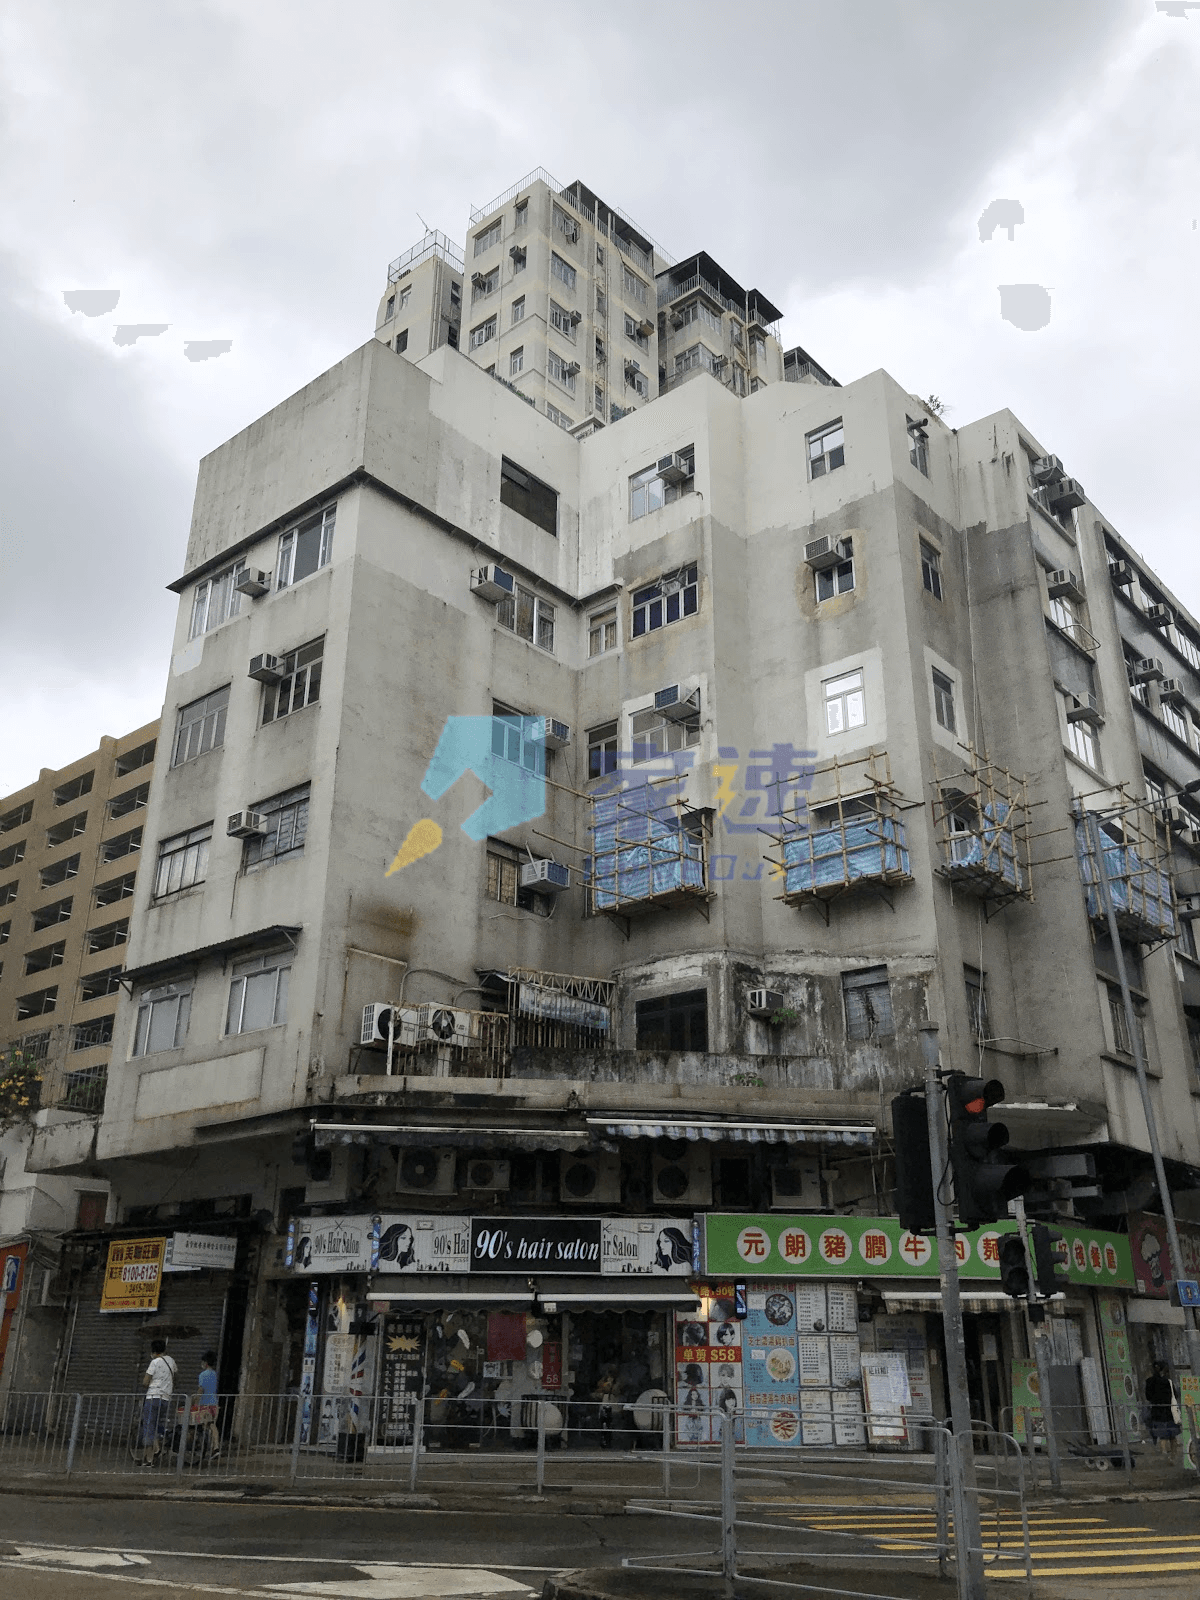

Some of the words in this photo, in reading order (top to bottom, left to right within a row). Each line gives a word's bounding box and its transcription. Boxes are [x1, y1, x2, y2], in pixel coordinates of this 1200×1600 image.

[326, 1231, 341, 1253] Hair
[341, 1231, 360, 1254] Salon
[433, 1232, 452, 1255] 90's
[474, 1229, 514, 1259] 90's
[516, 1238, 553, 1259] hair
[554, 1238, 599, 1260] salon
[612, 1234, 638, 1256] Salon
[122, 1264, 158, 1282] 8100-6125
[710, 1348, 735, 1361] $58
[546, 1374, 559, 1384] 58
